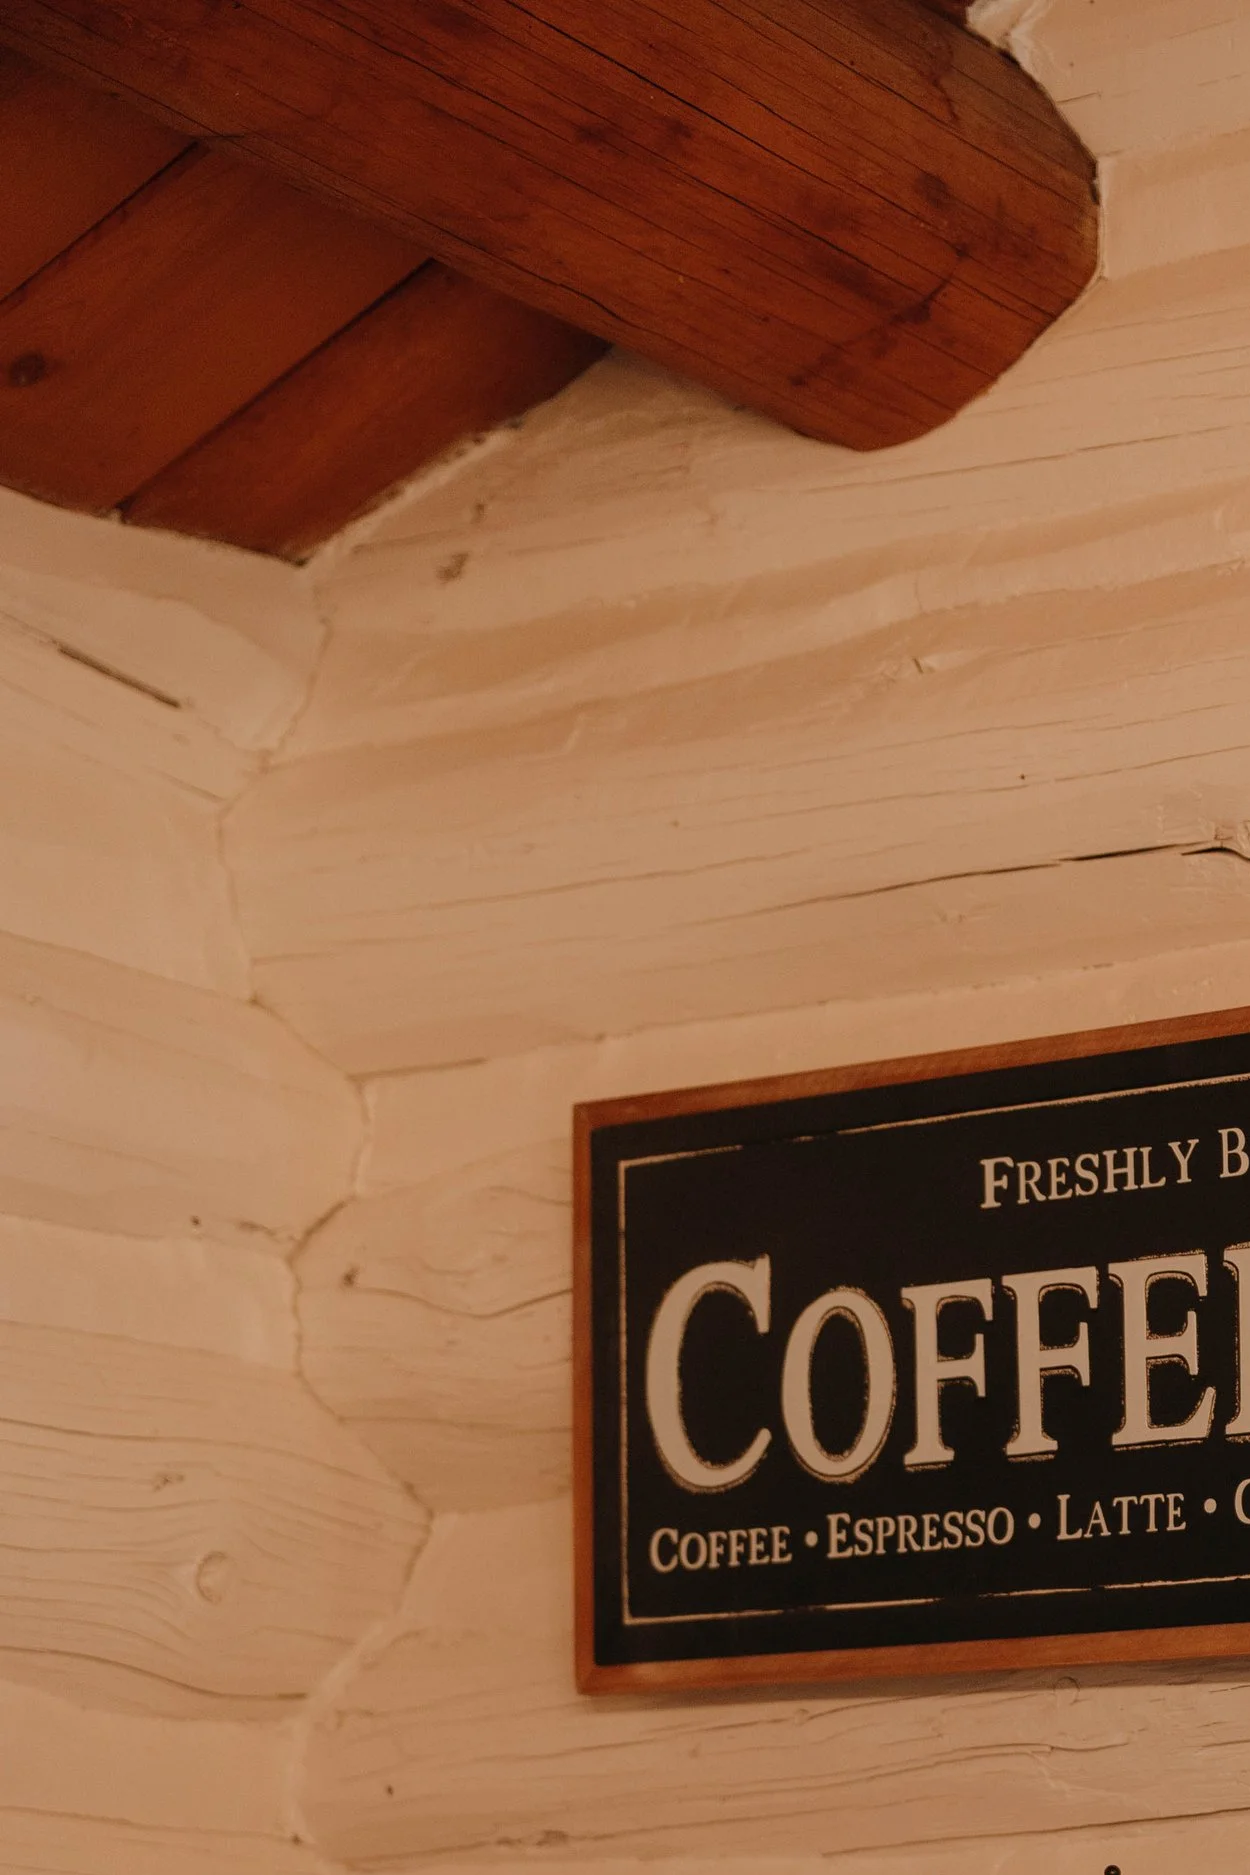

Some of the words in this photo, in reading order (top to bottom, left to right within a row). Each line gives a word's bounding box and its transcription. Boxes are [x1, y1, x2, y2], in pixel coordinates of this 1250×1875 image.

[980, 1139, 1199, 1208] FRESHLY
[650, 1527, 792, 1573] COFFEE
[827, 1507, 1014, 1558] ESPRESSO
[1057, 1493, 1186, 1540] LATTE
